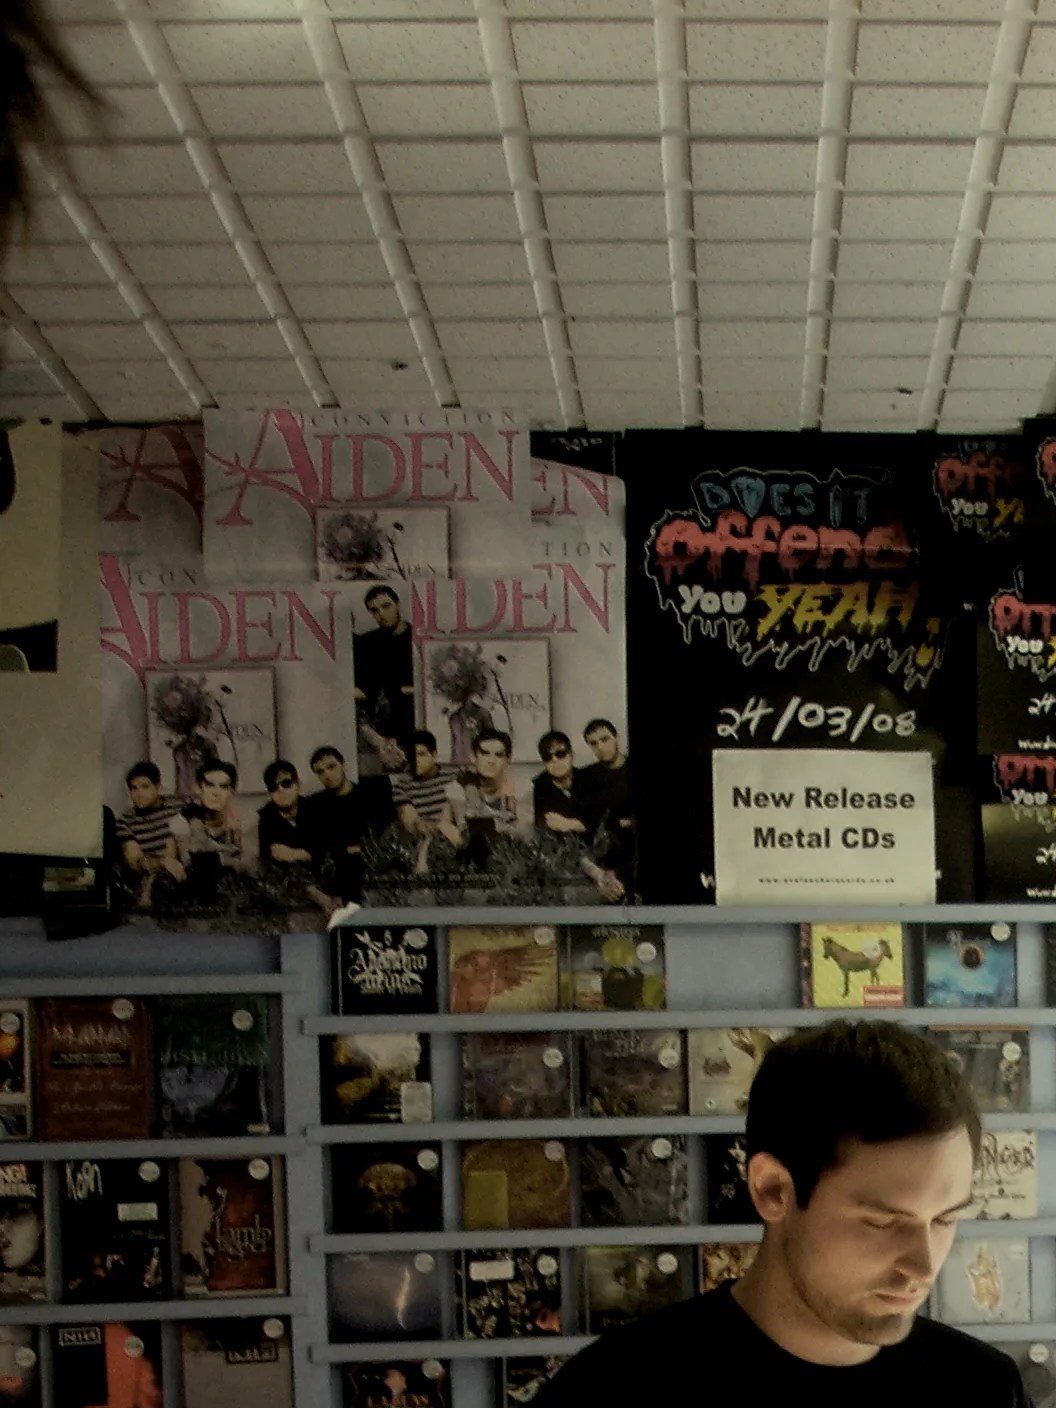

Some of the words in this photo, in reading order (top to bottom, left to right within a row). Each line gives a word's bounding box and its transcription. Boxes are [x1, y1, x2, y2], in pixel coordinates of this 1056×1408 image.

[311, 411, 516, 427] CONVICTION
[204, 408, 519, 525] AIDEN
[655, 507, 912, 585] offend
[716, 696, 918, 742] 24/03/08
[732, 786, 795, 810] New
[804, 786, 916, 810] Release
[753, 827, 831, 850] Metal
[841, 828, 896, 850] CDs
